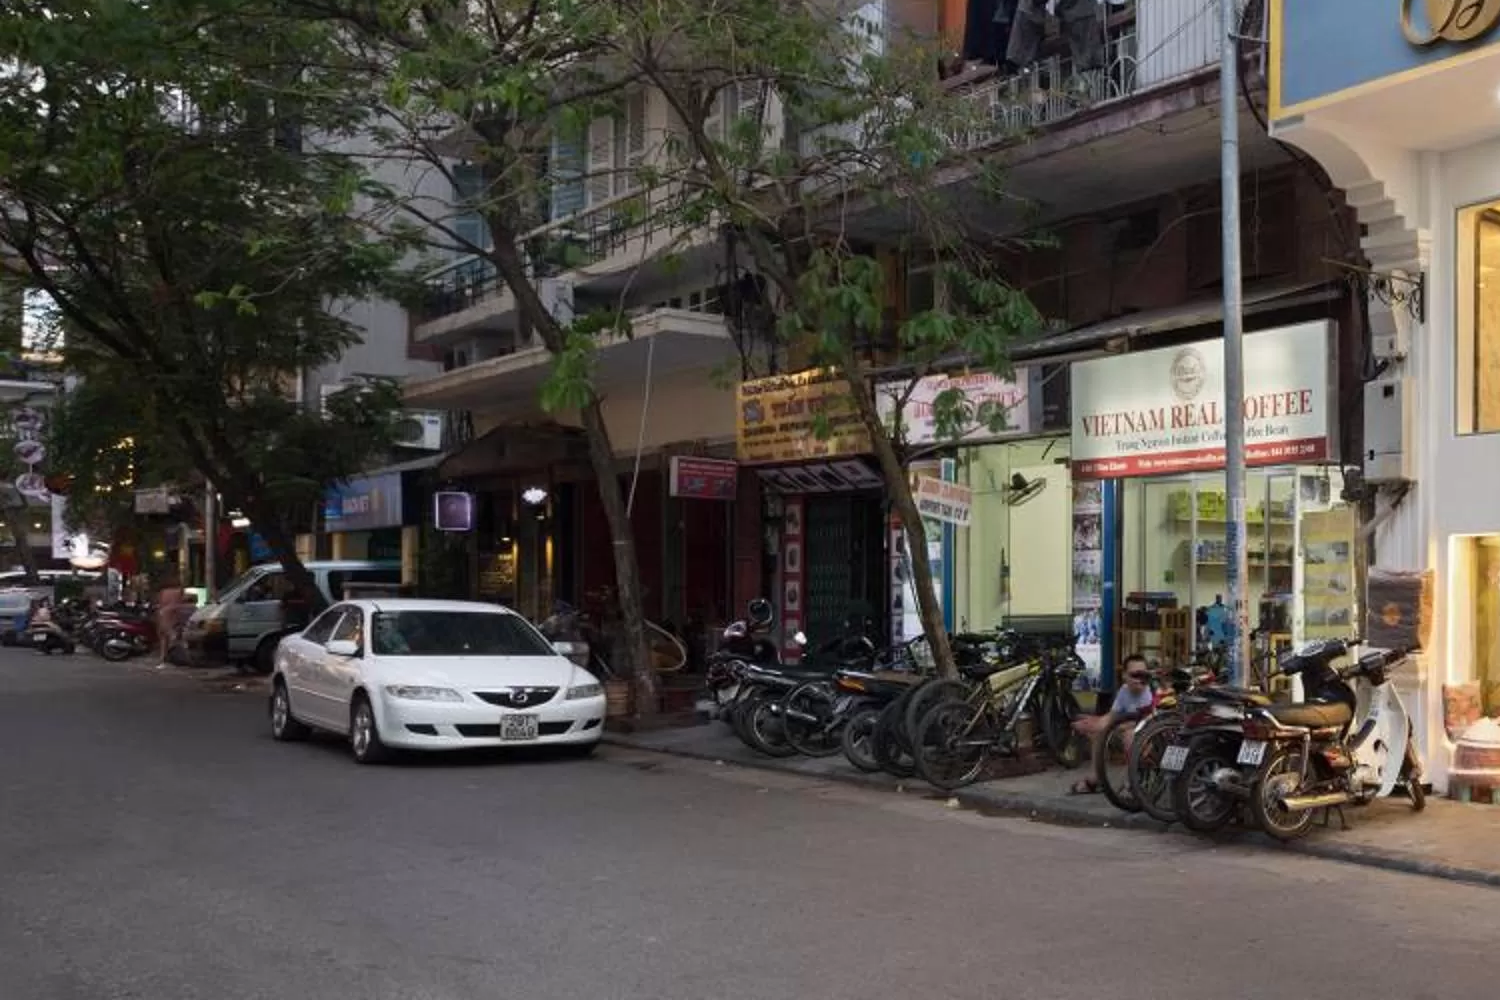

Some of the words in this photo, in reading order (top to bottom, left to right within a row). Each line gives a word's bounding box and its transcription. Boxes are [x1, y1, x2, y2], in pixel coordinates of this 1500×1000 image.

[1081, 408, 1165, 437] VIETNAM
[1170, 401, 1223, 429] REAL
[1242, 389, 1313, 421] OFFEE
